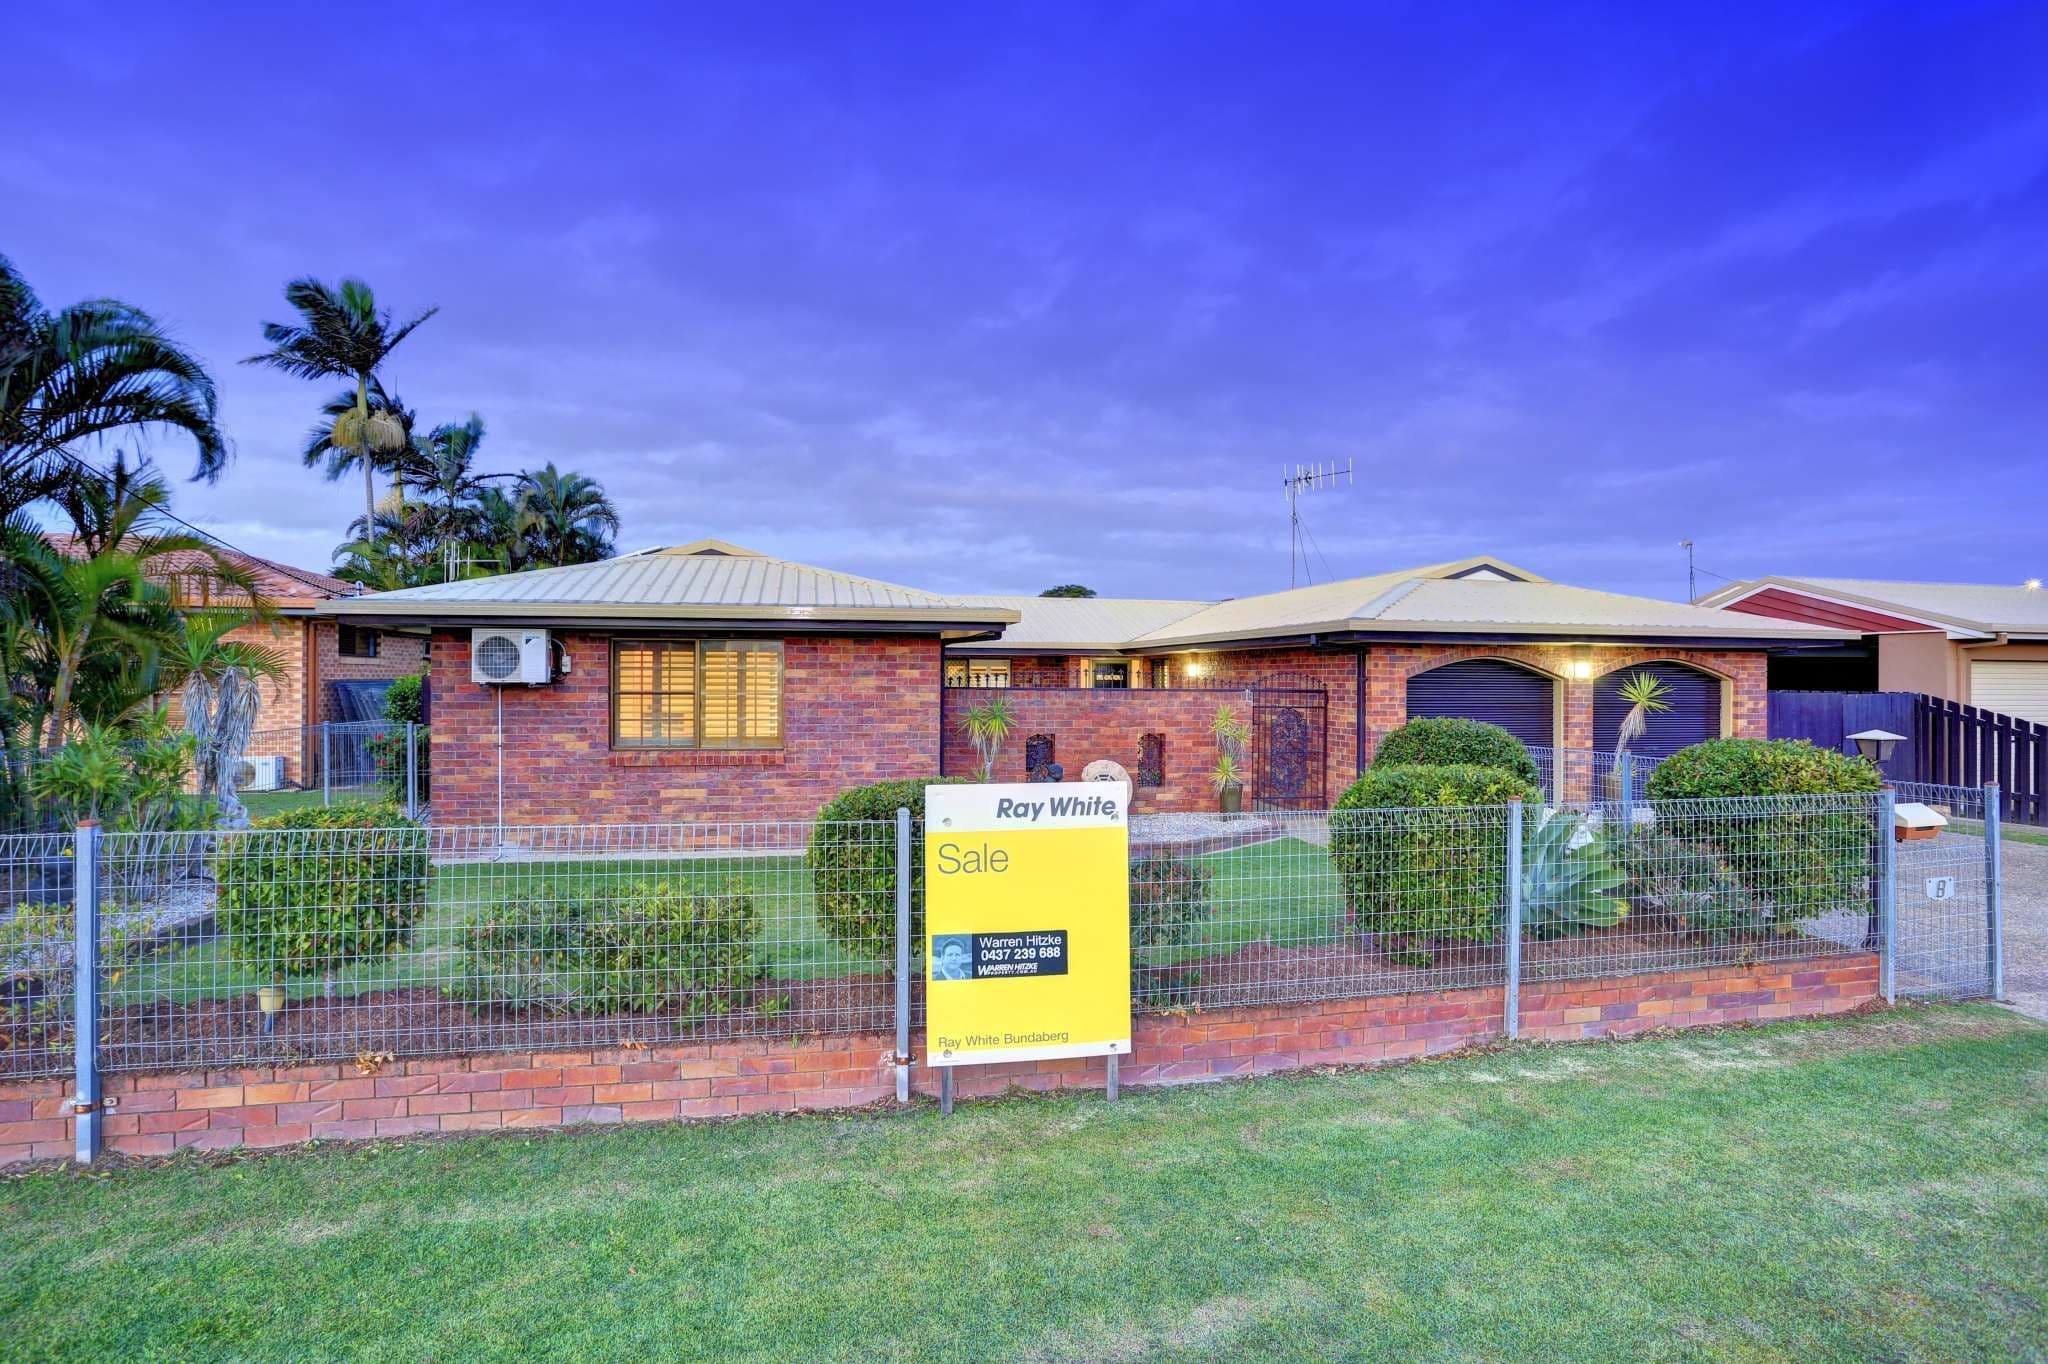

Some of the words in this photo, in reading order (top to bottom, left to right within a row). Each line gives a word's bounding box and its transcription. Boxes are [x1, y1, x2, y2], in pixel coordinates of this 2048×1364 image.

[996, 798, 1045, 821] Ray
[937, 842, 1009, 874] Sale
[1936, 880, 1946, 898] 8
[979, 936, 1023, 948] Warren
[1026, 934, 1062, 946] Hitzke
[981, 949, 1011, 961] 0437
[1014, 948, 1036, 960] 239
[1039, 946, 1061, 958] 688
[978, 963, 1014, 976] WARREN
[1014, 962, 1038, 971] HITZKE
[938, 1037, 961, 1049] Ray
[965, 1035, 1000, 1046] White
[1004, 1031, 1069, 1044] Bundaberg
